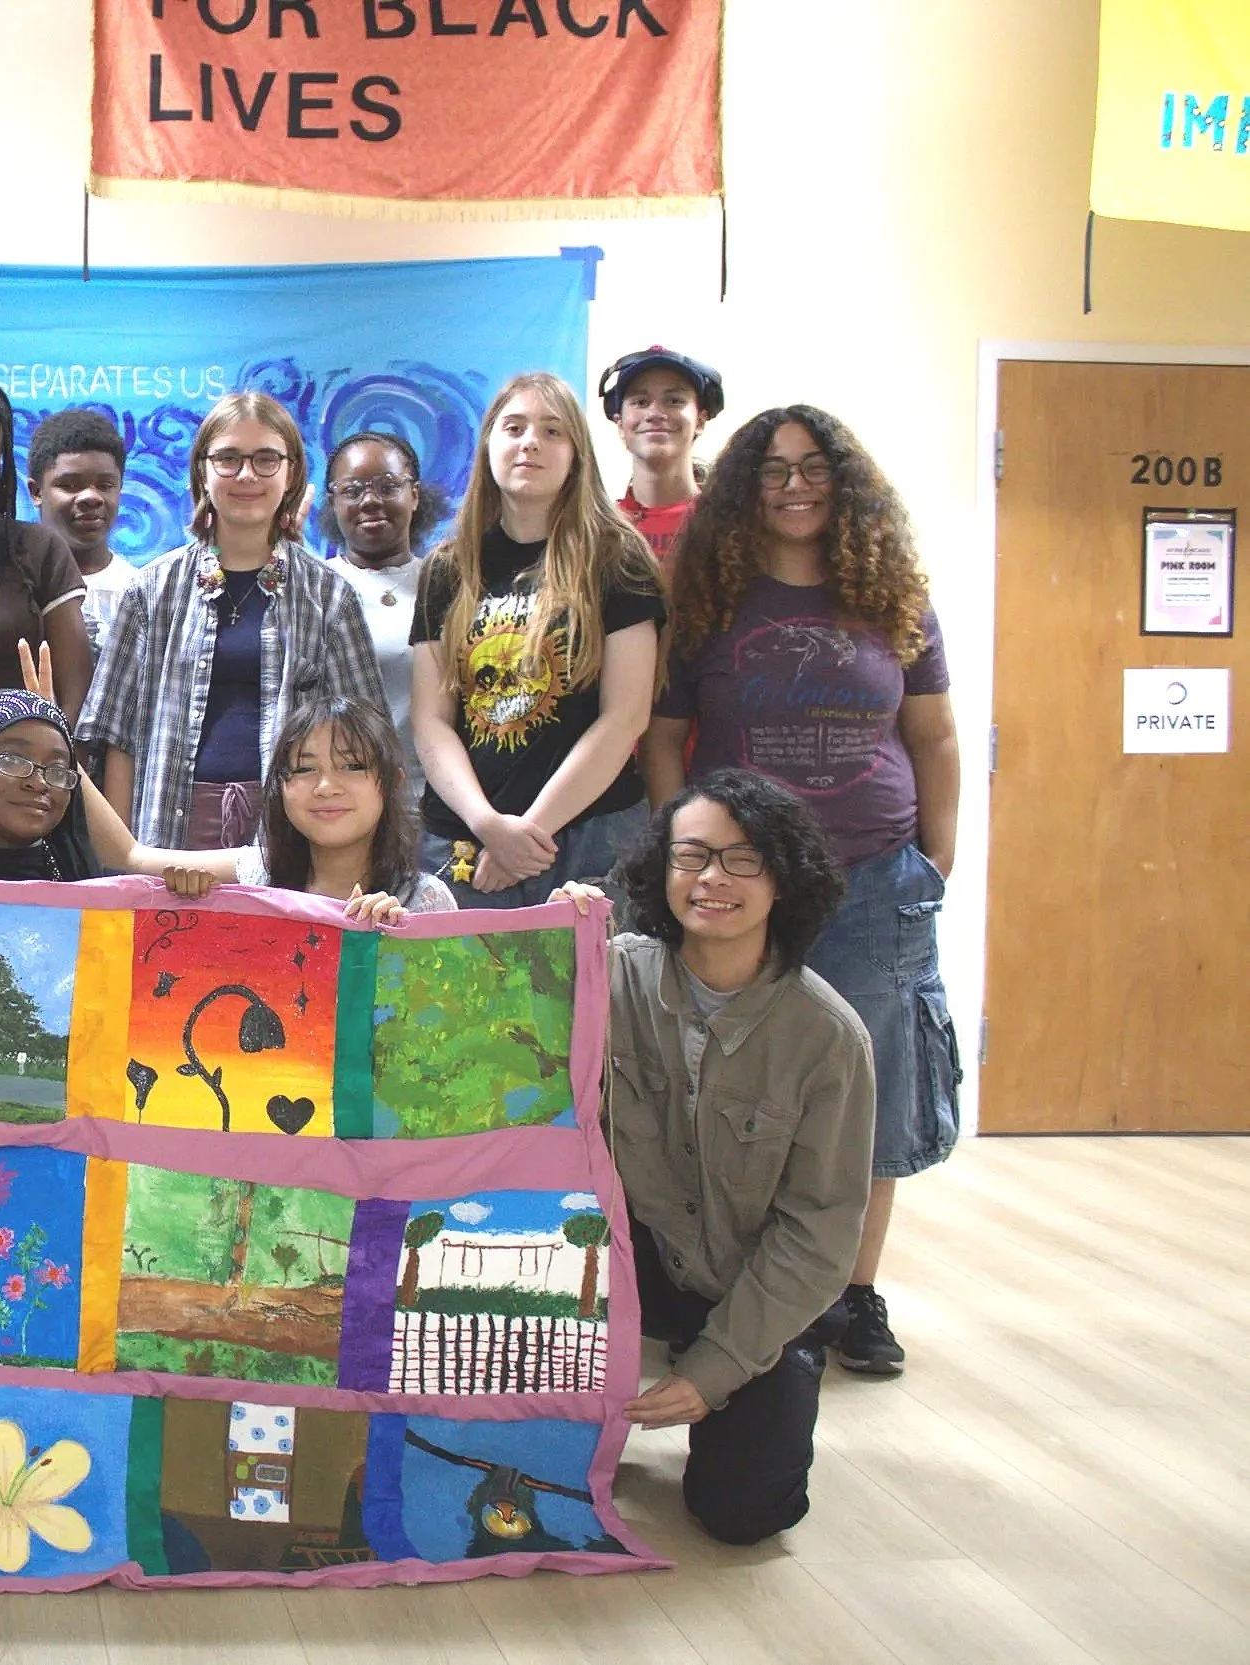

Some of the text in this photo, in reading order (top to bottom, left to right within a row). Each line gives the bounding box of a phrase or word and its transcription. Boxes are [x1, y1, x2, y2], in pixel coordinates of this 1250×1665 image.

[152, 0, 669, 39] OR BLACK
[149, 54, 402, 142] LIVES
[180, 364, 227, 400] US
[1161, 560, 1216, 570] PINK ROOM
[1136, 715, 1215, 730] PRIVATE
